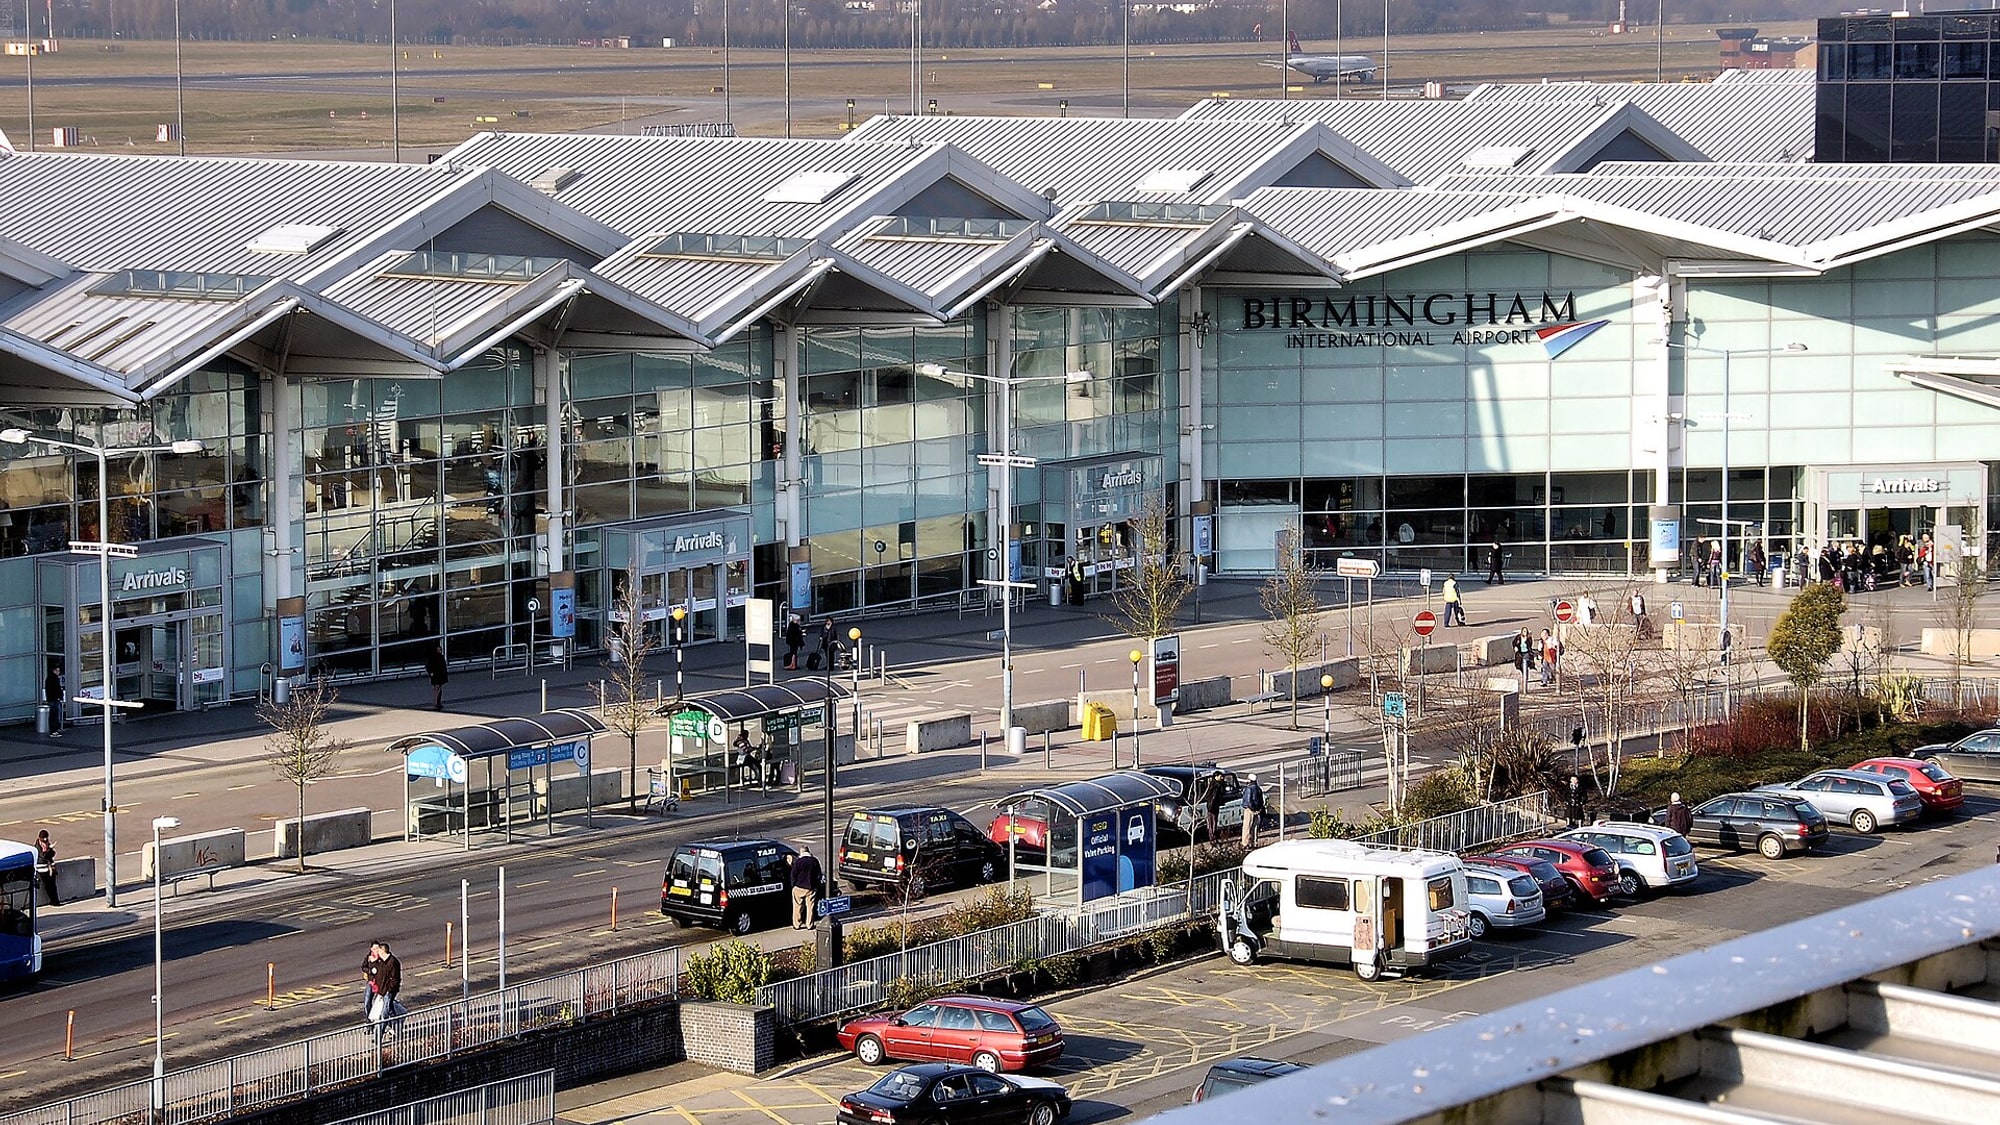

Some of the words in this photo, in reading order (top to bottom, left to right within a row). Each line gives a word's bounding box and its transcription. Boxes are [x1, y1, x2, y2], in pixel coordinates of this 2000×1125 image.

[1242, 290, 1577, 330] BIRMINGHAM
[1286, 330, 1435, 349] INTERNATIONAL
[1452, 328, 1532, 346] AIRPORT
[1102, 469, 1142, 489] Arrivals
[1871, 477, 1940, 494] Arrivals
[674, 531, 723, 553] Arrivals
[122, 566, 186, 591] Arrivals
[714, 724, 722, 736] D
[578, 745, 586, 760] C
[451, 760, 463, 775] C
[930, 814, 948, 823] TAXI
[757, 848, 776, 857] TAXI
[1096, 845, 1115, 856] Parking
